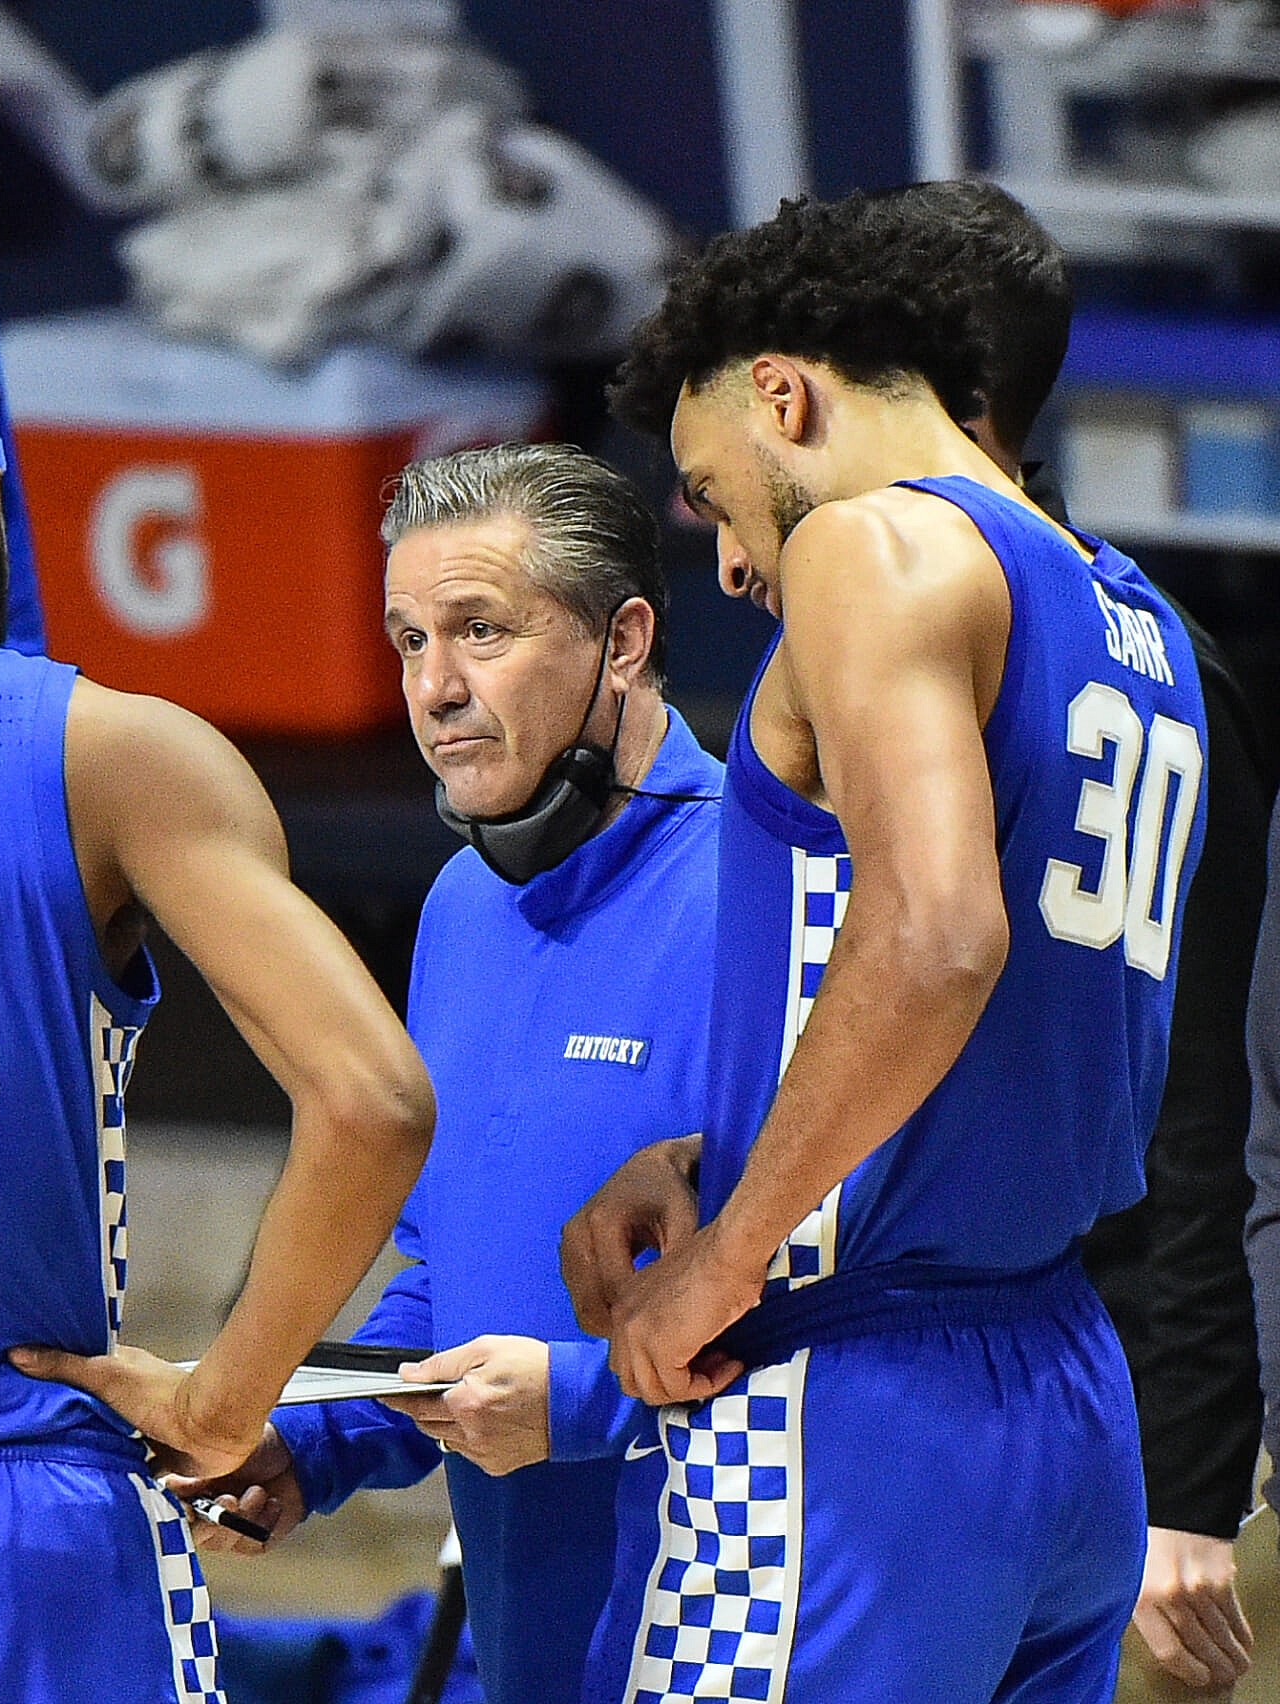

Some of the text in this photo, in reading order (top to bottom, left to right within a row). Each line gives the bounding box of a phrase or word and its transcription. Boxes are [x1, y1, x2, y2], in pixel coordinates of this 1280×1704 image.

[89, 463, 210, 637] G
[1091, 580, 1175, 687] SARR
[1037, 680, 1204, 982] 30
[563, 1034, 645, 1065] KENTUCKY
